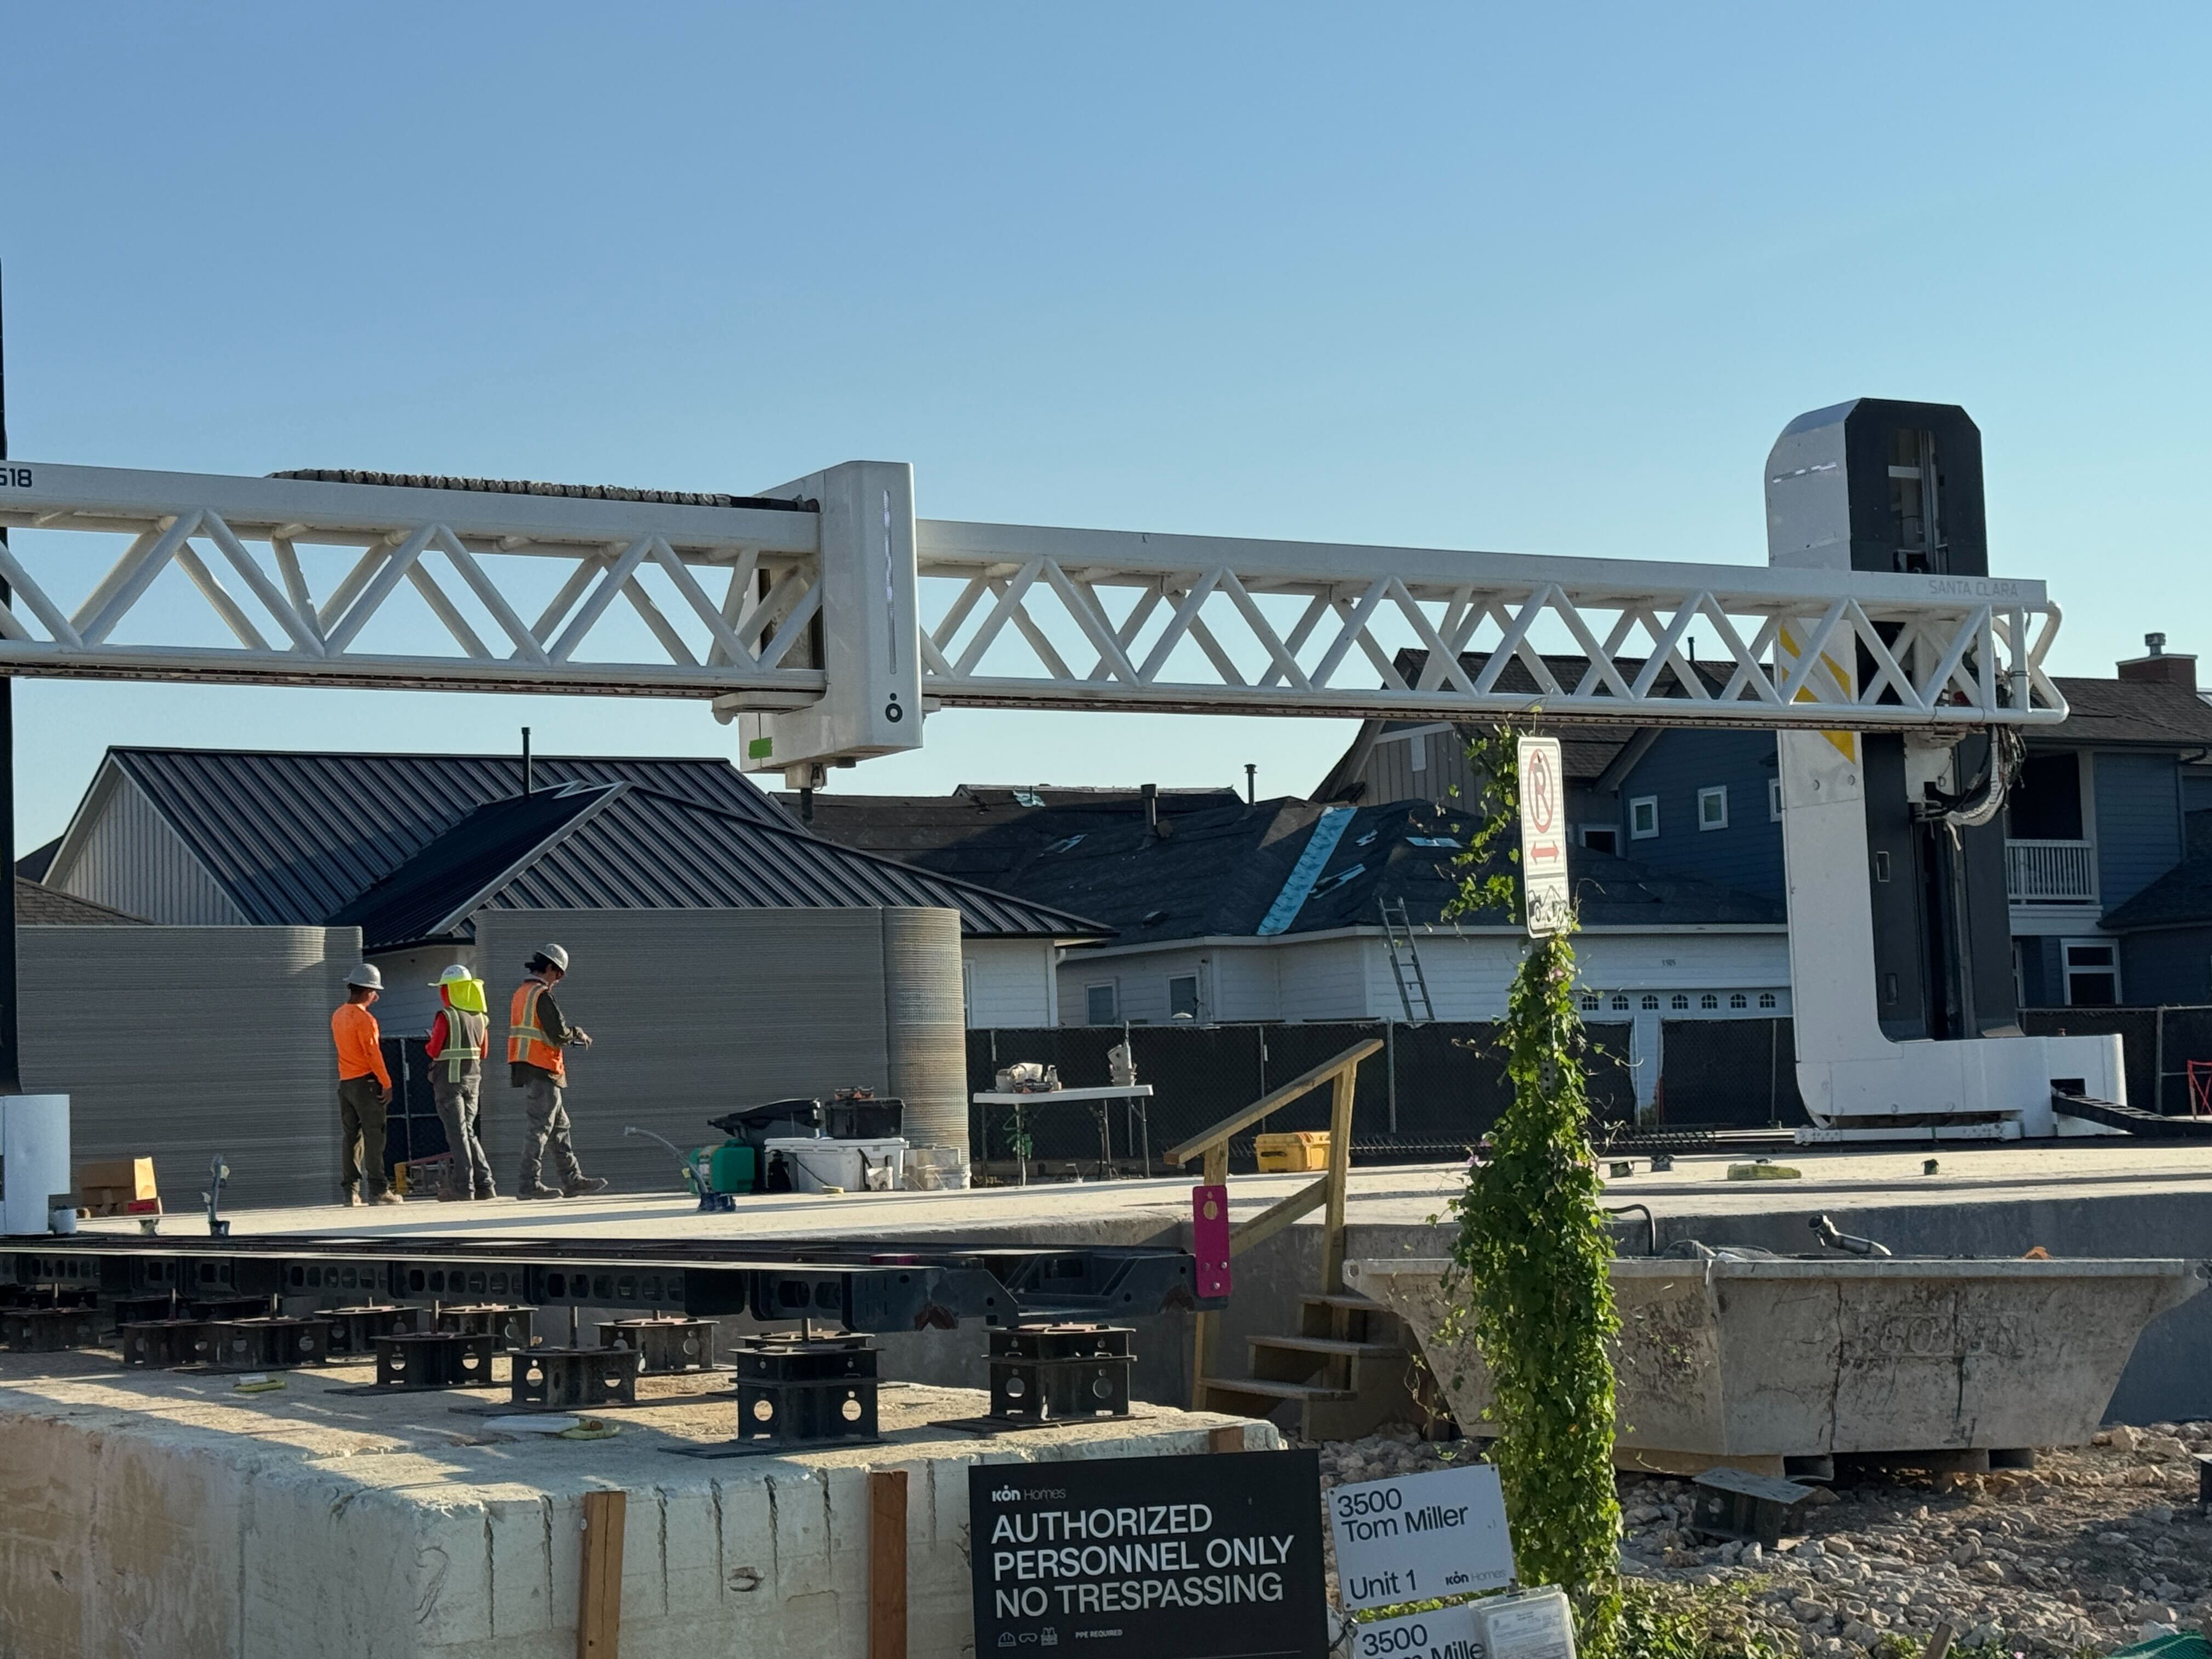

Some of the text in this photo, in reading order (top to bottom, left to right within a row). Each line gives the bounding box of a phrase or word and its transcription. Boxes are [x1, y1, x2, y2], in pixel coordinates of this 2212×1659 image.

[1929, 580, 2018, 597] SANTA CLARA
[1023, 1488, 1066, 1501] Homes
[1338, 1488, 1402, 1518] 3500
[991, 1504, 1212, 1544] AUTHORIZED
[1341, 1505, 1469, 1542] Tom Miller
[994, 1534, 1294, 1581] PERSONNEL ONLY
[1349, 1569, 1417, 1600] Unit 1
[1471, 1570, 1506, 1581] Homes
[996, 1572, 1283, 1618] NO TRESPASSING
[1090, 1629, 1123, 1638] REQUIRED
[1362, 1624, 1427, 1656] 3500
[1430, 1640, 1487, 1659] Mille
